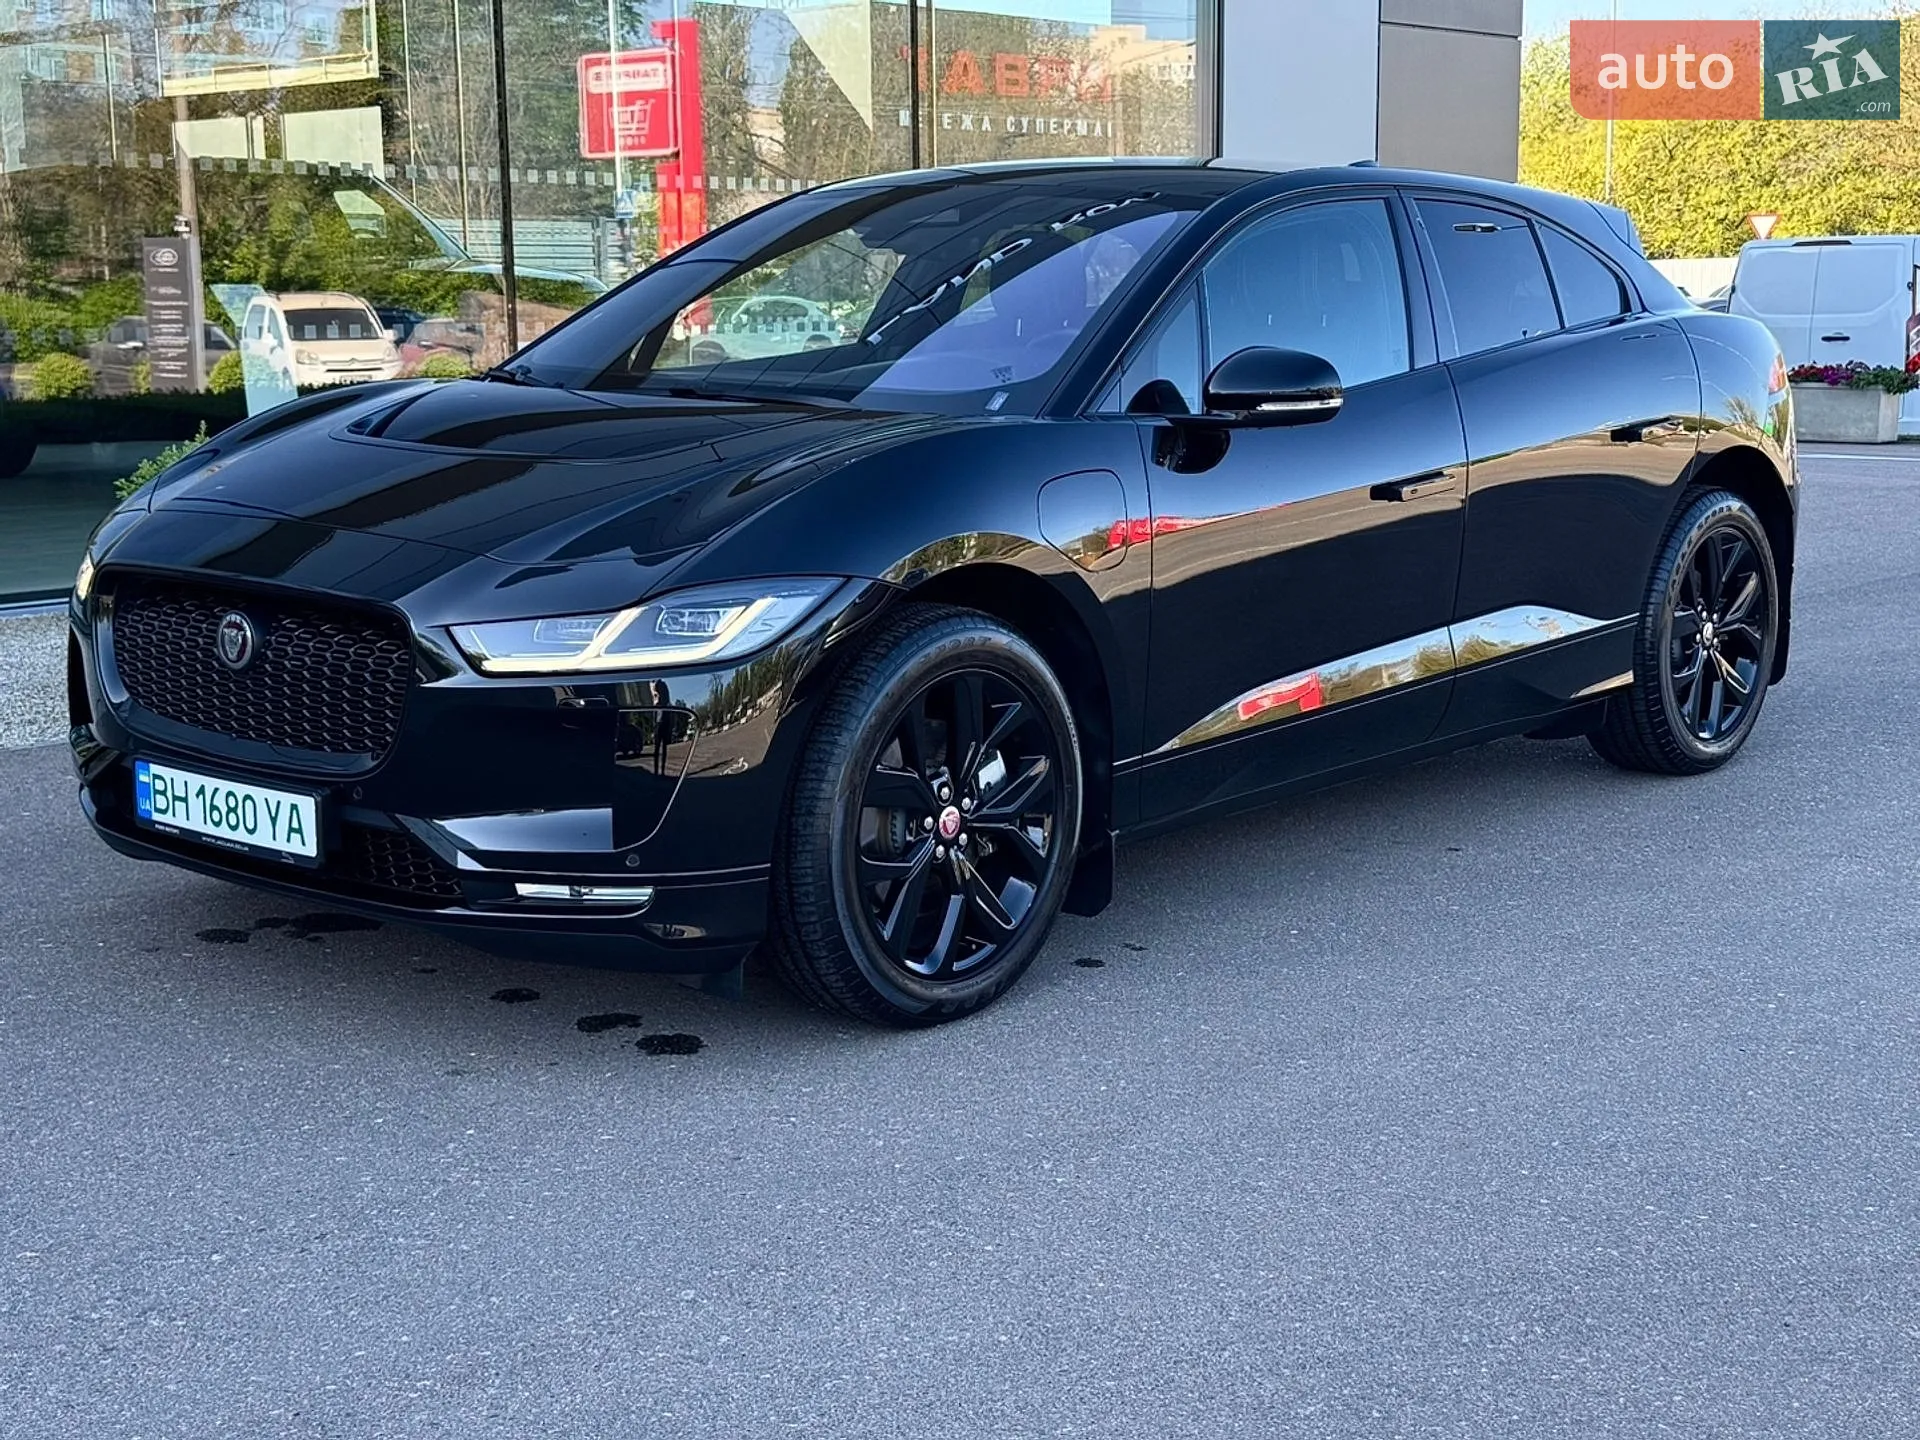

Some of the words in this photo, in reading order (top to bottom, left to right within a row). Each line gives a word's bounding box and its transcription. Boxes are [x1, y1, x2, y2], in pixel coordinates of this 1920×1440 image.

[152, 773, 190, 821] BH
[195, 784, 258, 836] 1680
[264, 797, 306, 847] YA
